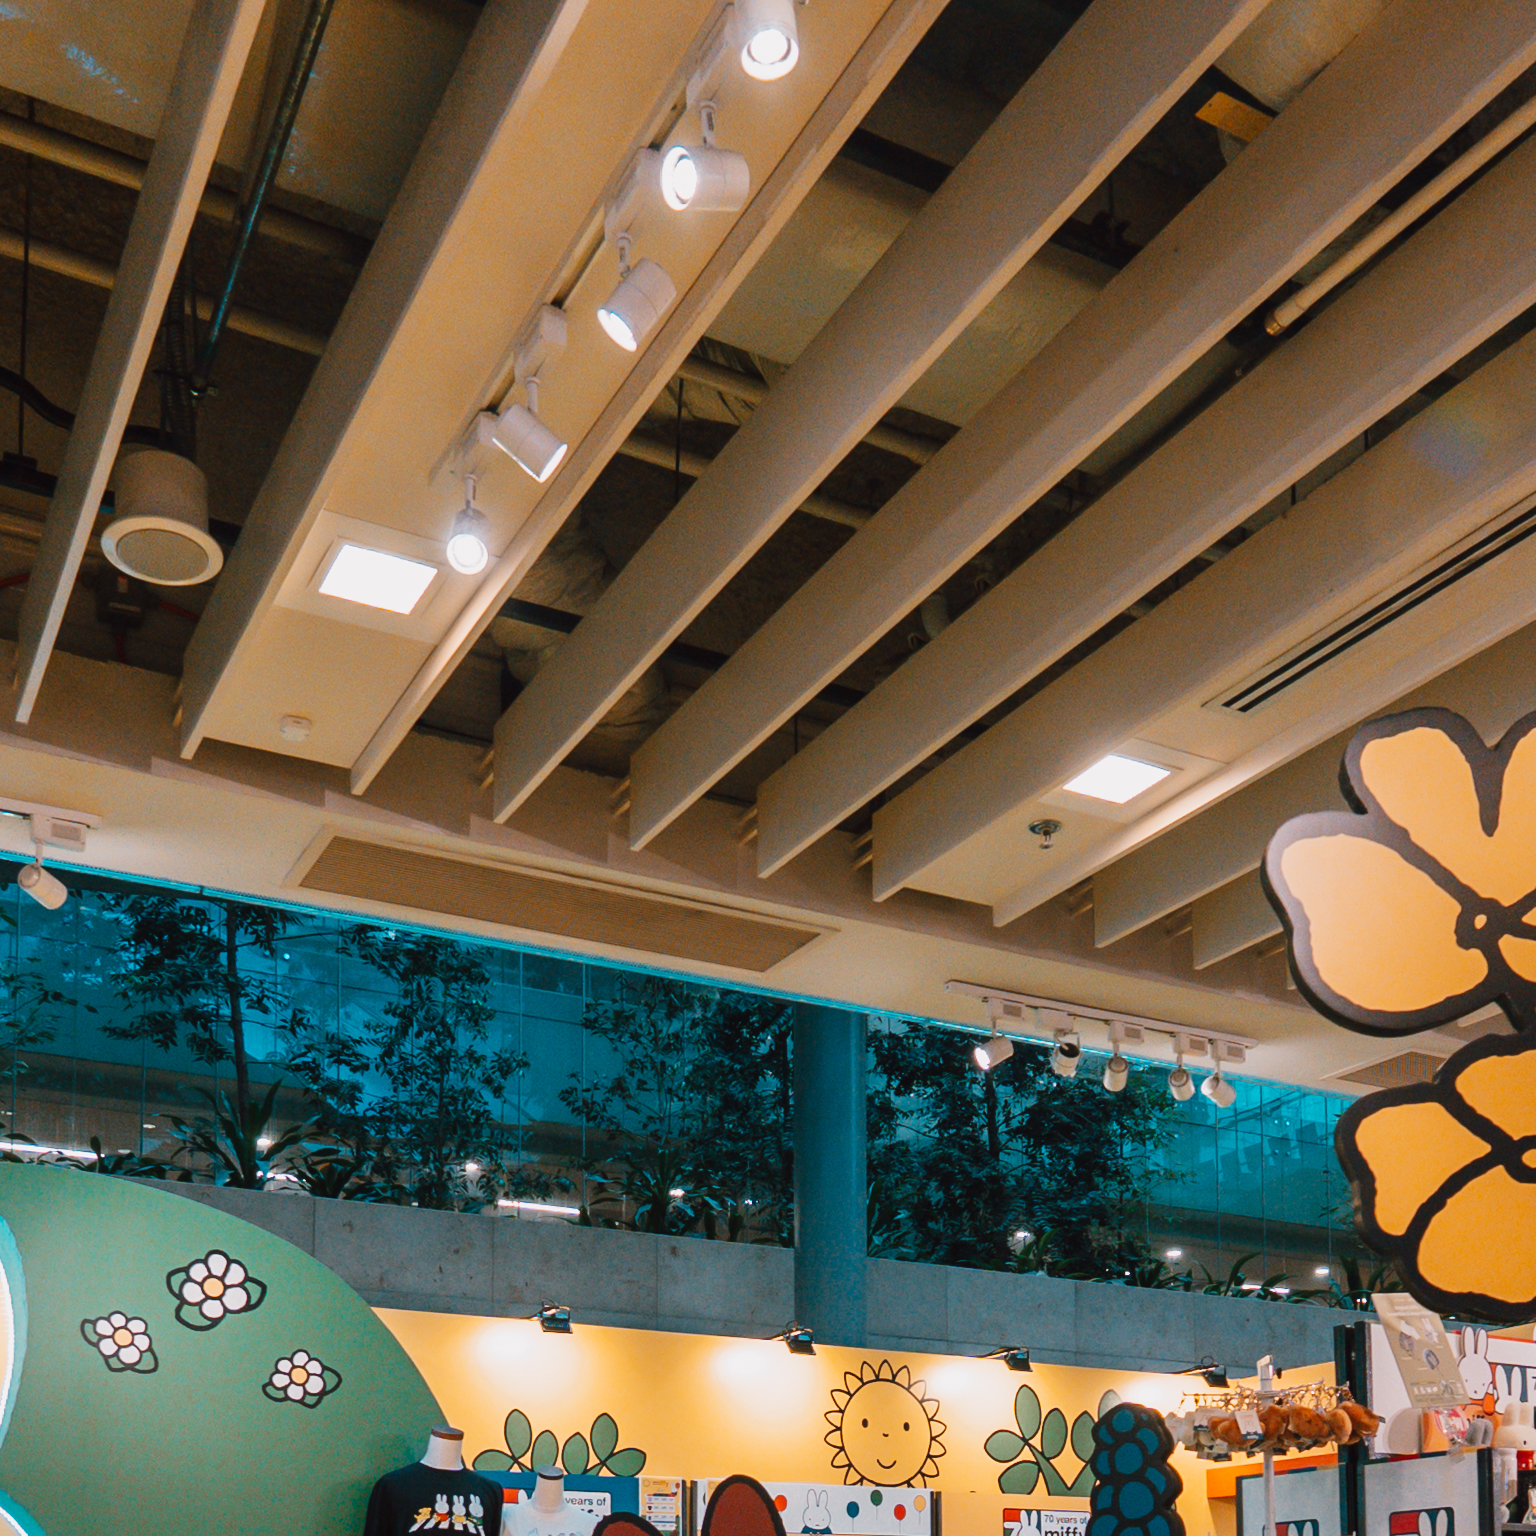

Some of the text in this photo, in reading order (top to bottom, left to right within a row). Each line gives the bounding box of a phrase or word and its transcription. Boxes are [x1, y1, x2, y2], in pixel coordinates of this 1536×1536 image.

[597, 1496, 606, 1506] of
[1044, 1515, 1088, 1525] 70 years of
